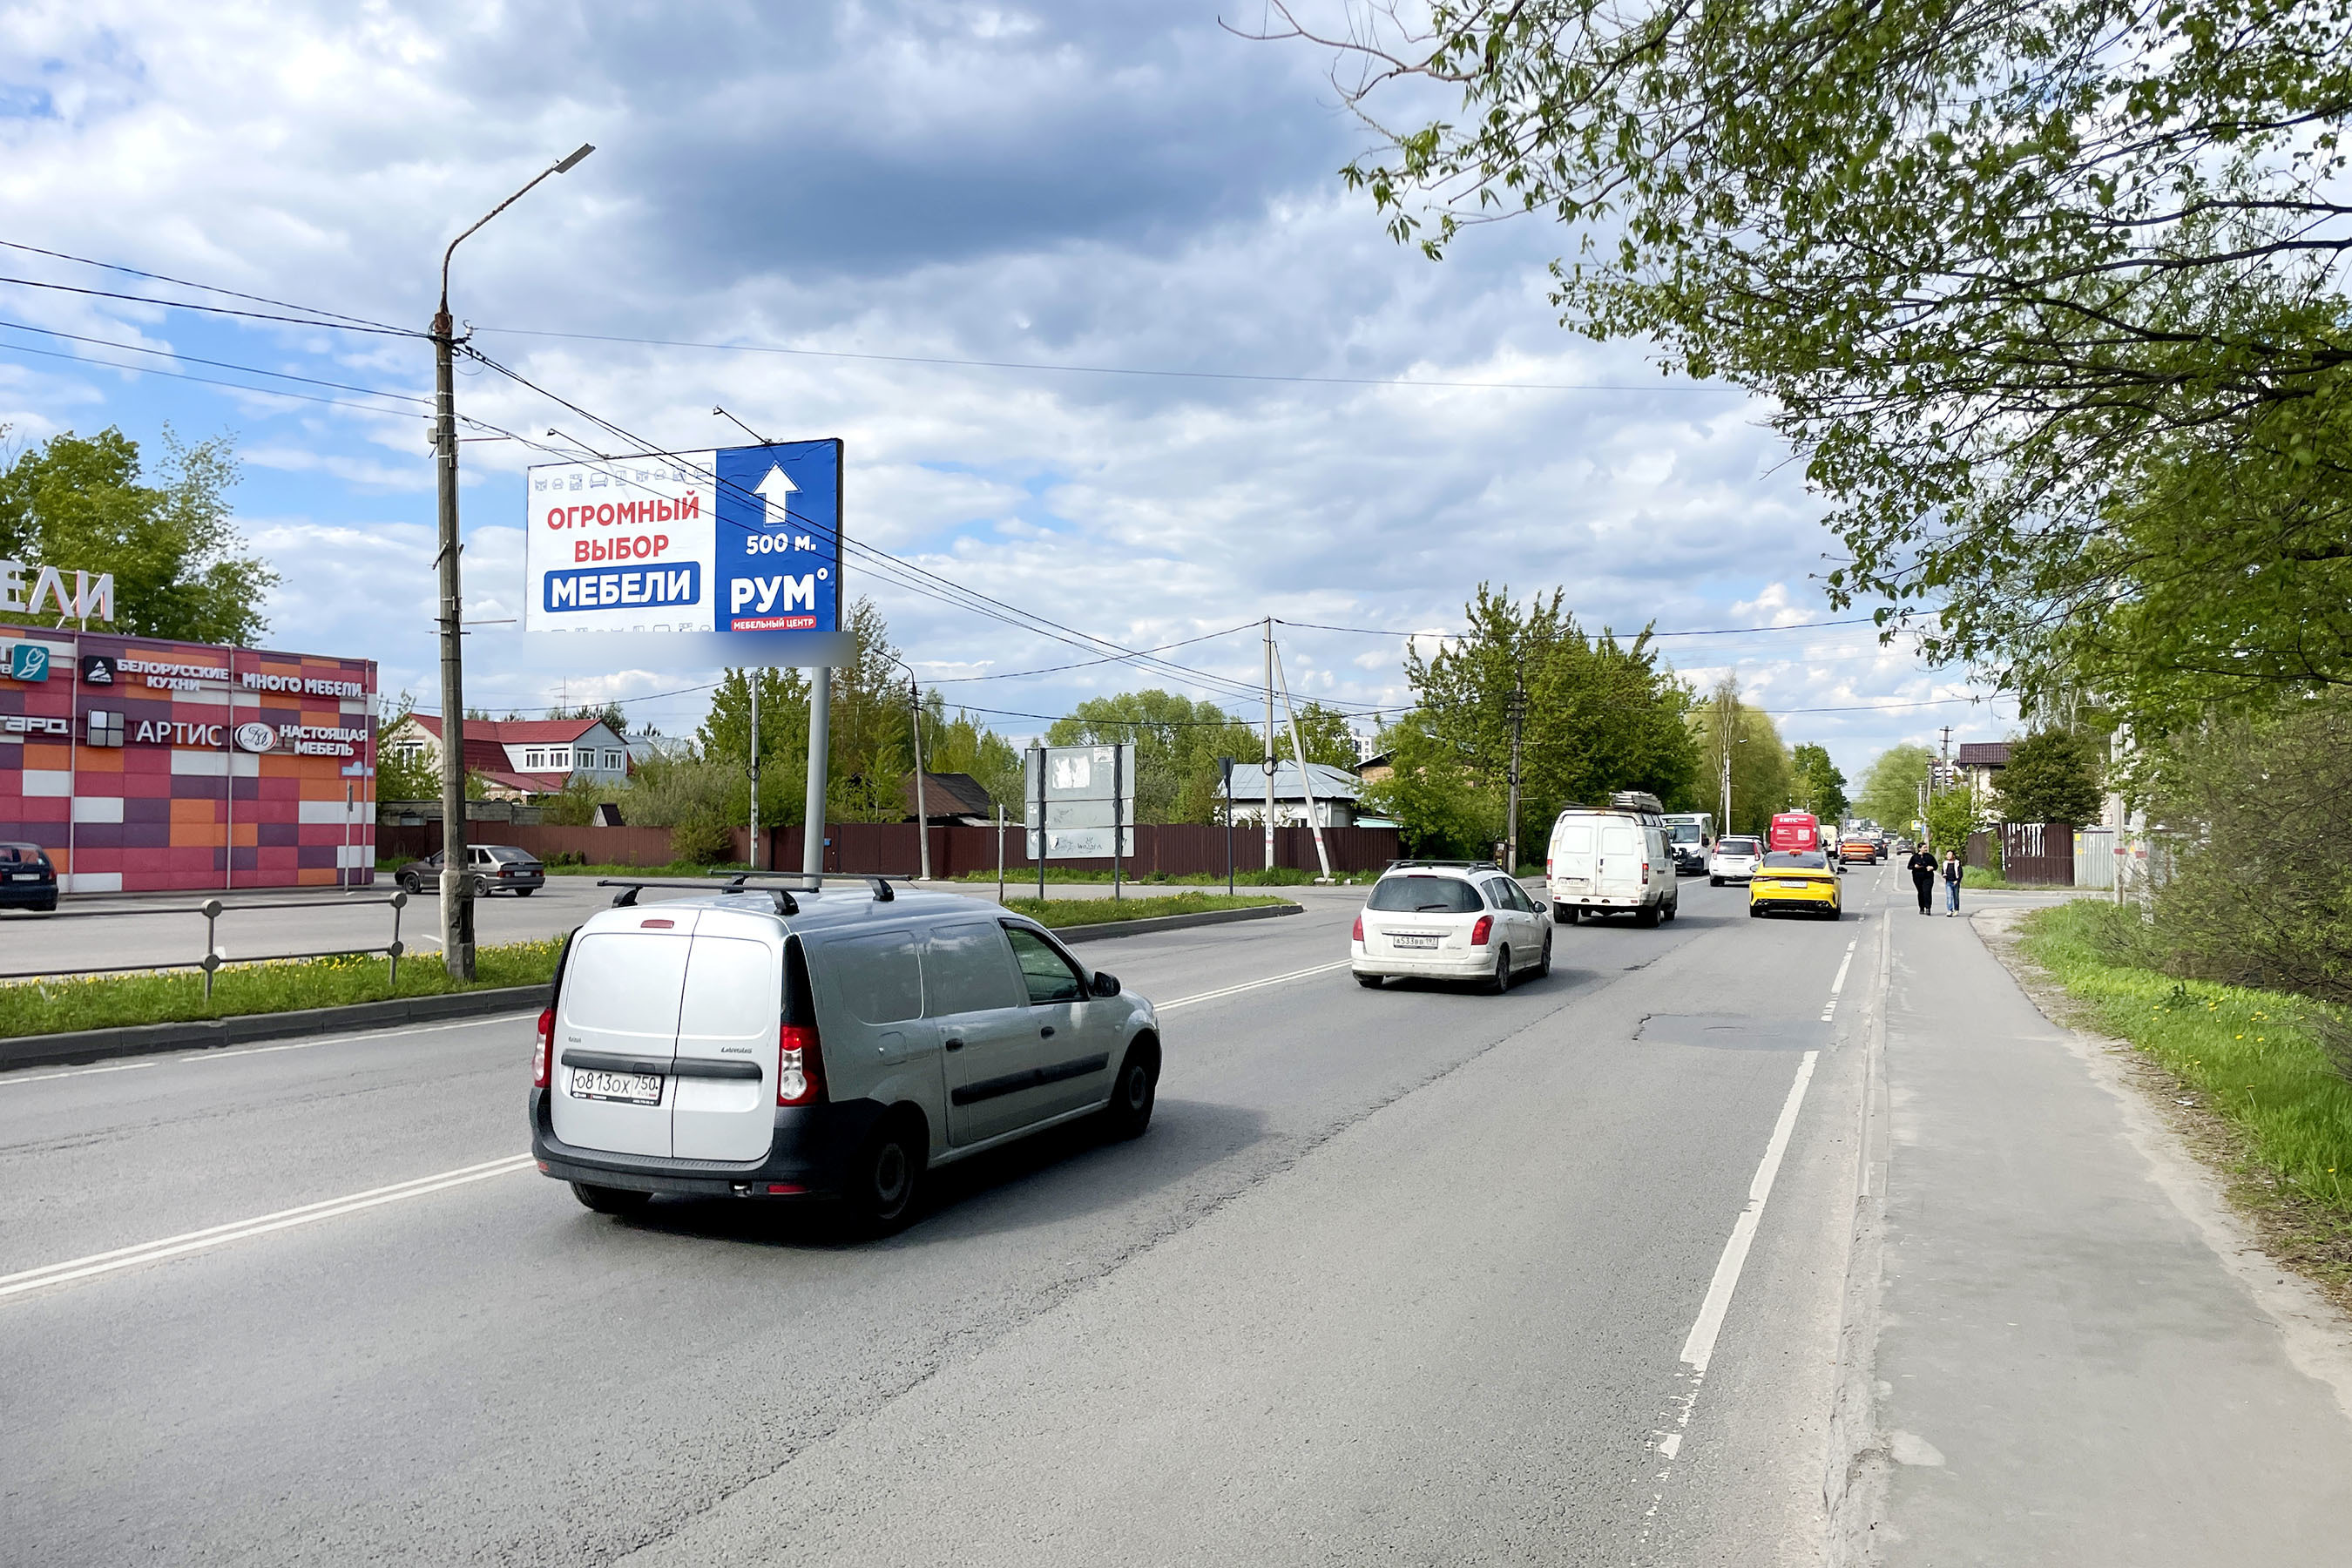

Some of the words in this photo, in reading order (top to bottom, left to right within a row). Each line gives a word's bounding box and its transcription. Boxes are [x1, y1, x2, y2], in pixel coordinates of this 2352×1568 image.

[547, 490, 700, 531] ОГРОМНЫЙ
[574, 534, 669, 563] ВЫБОР
[746, 532, 788, 555] 500
[551, 569, 691, 608] МЕБЕЛИ
[733, 618, 785, 630] МЕБЕЛЬНЫЙ
[787, 618, 814, 628] ЦЕНТР
[117, 659, 230, 680] БЕЛОРУССКИЕ
[146, 675, 201, 692] КУХНИ
[242, 672, 302, 693] МНОГО
[304, 678, 362, 698] МЕБЕЛИ
[135, 720, 223, 747] АРТИС
[280, 725, 368, 742] НАСТОЯЩАЯ
[294, 740, 355, 756] МЕБЕЛЬ
[634, 1075, 657, 1092] 750
